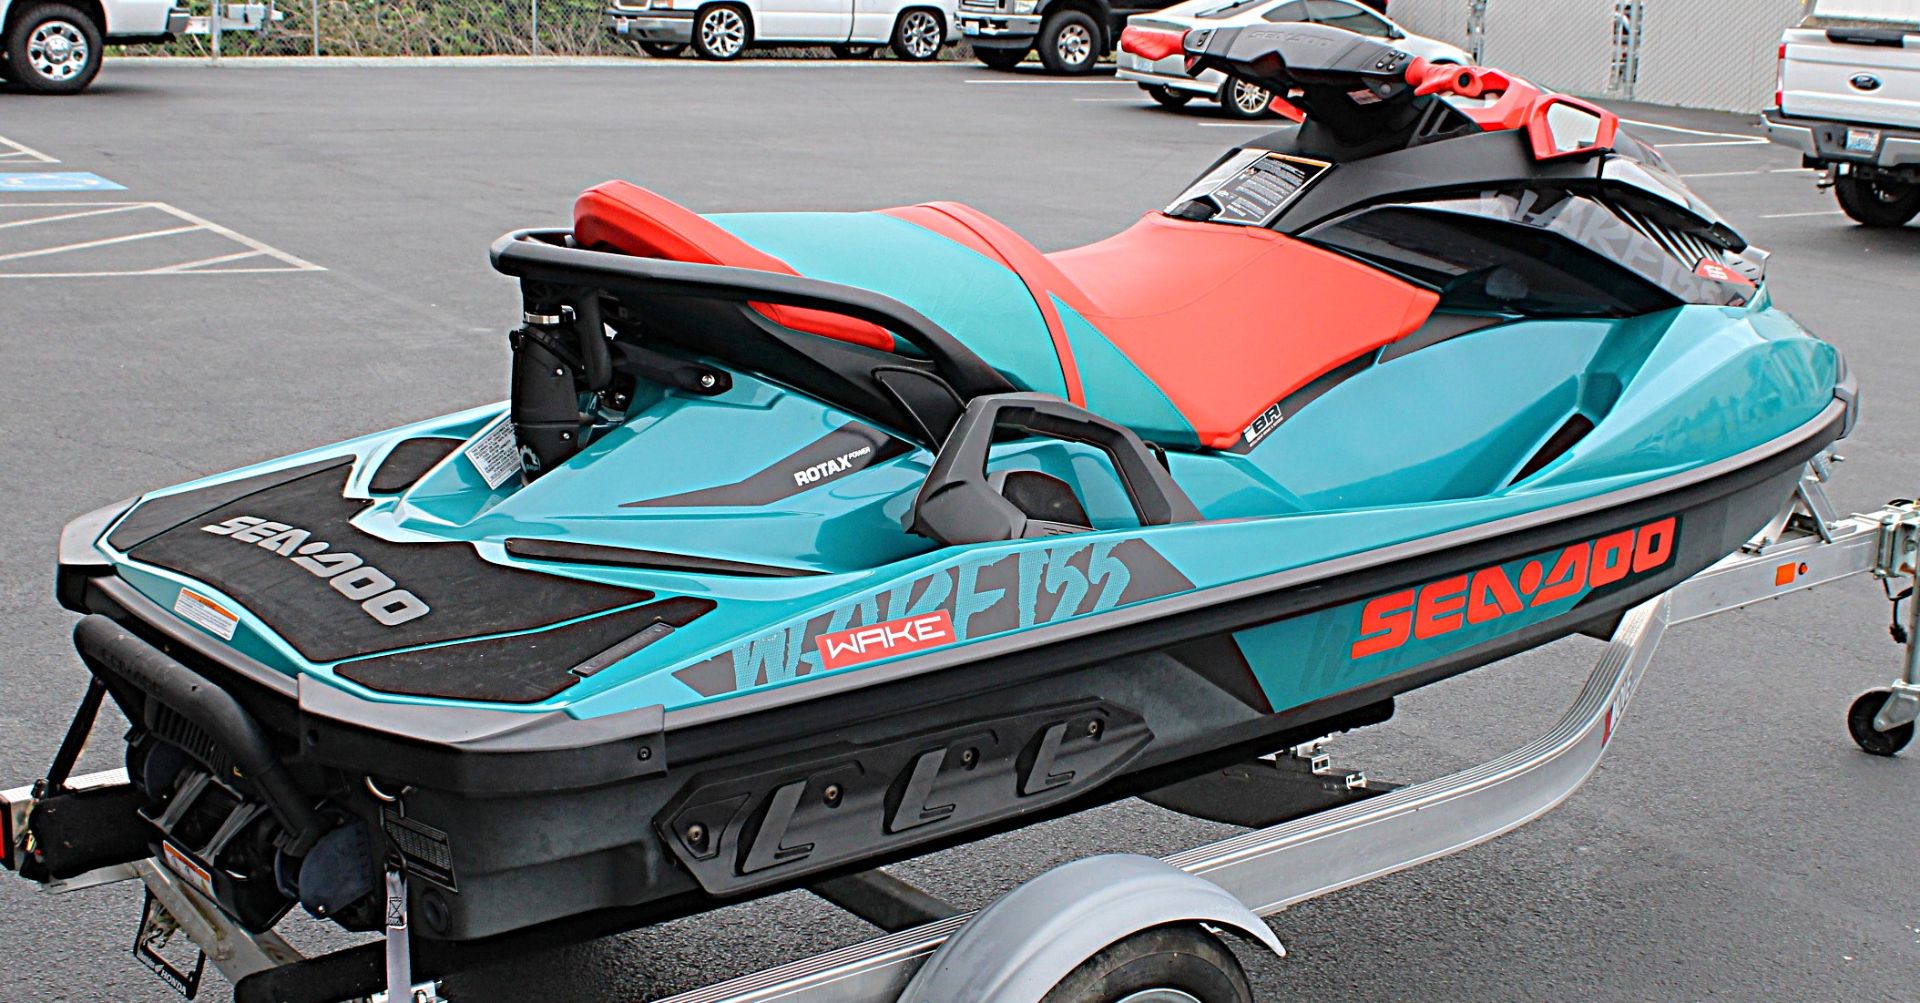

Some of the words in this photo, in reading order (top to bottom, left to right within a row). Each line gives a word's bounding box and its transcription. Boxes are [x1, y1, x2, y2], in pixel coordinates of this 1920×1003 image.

[793, 454, 853, 487] ROTAX
[848, 446, 871, 460] POWER
[825, 615, 946, 661] WAKE
